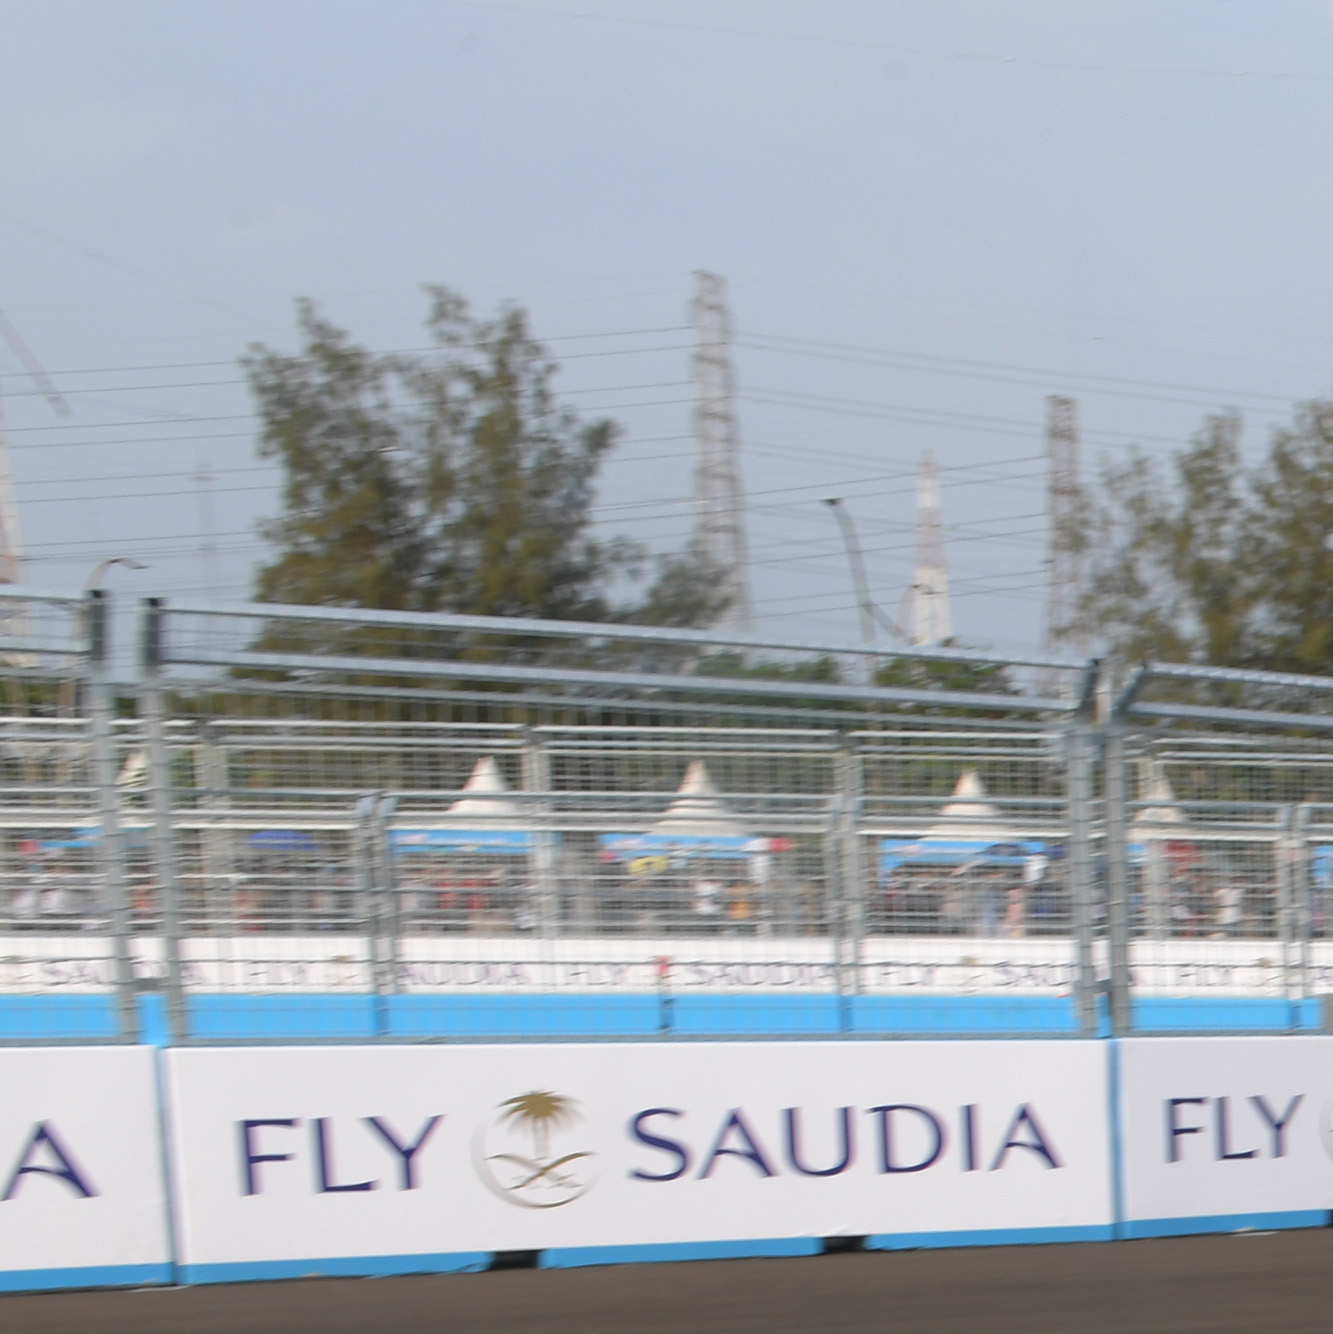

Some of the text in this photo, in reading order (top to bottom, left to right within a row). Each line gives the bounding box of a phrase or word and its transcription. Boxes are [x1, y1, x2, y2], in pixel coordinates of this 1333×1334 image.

[239, 1102, 1065, 1196] FLY SAUDIA
[1163, 1093, 1306, 1163] FLY
